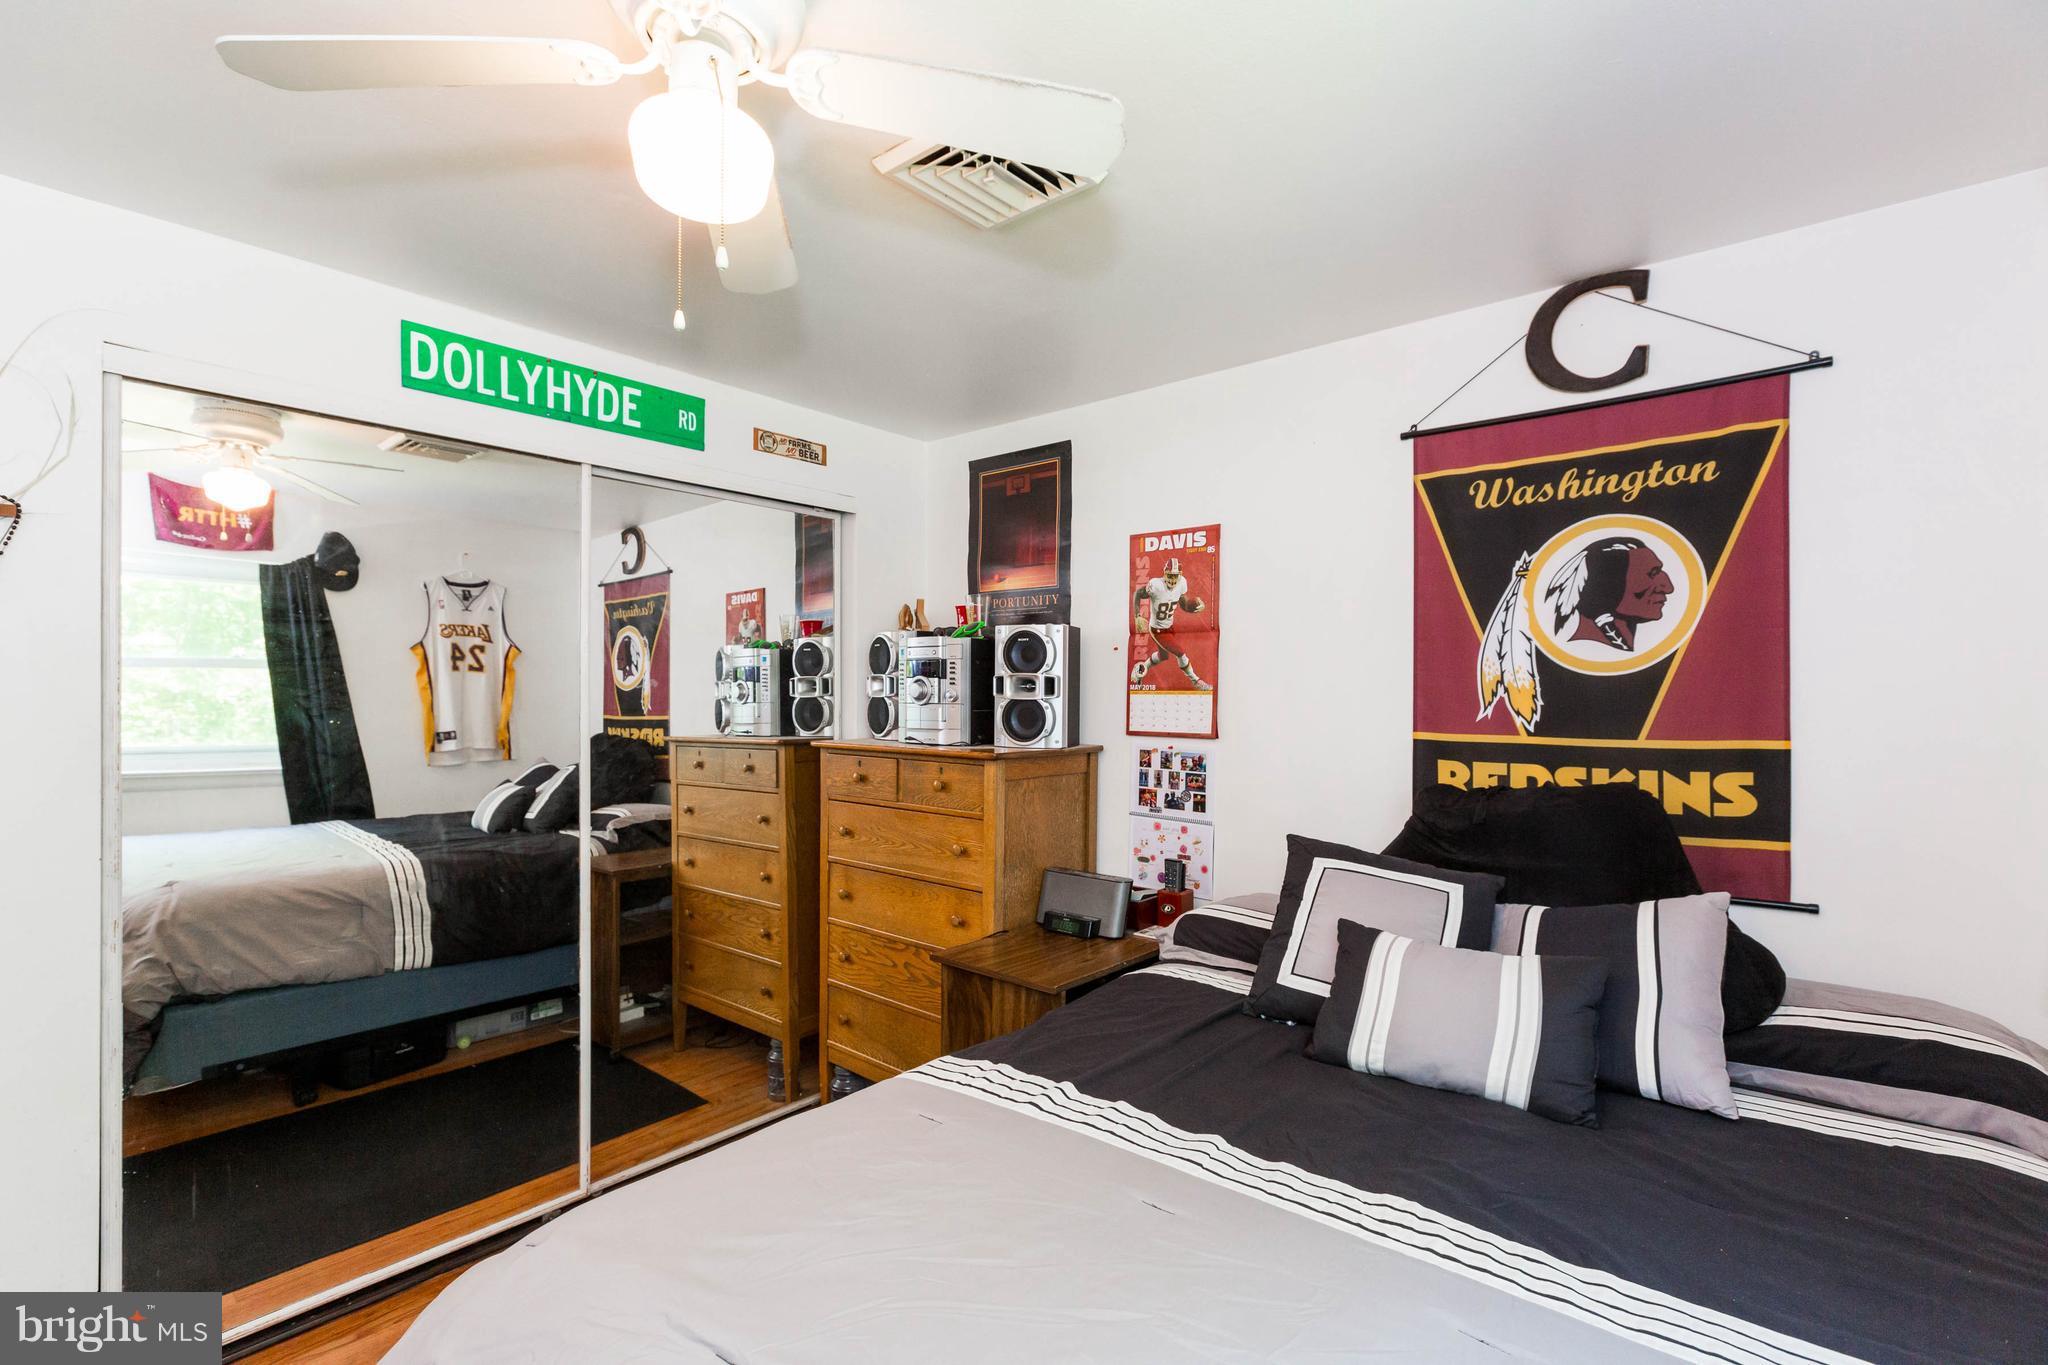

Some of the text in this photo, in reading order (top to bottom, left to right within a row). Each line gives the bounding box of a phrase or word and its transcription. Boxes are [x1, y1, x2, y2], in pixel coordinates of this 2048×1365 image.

[1525, 269, 1650, 394] C
[409, 331, 697, 431] DOLLYHYDE RD
[788, 439, 812, 450] FARMS
[798, 449, 820, 461] BEER
[1469, 459, 1720, 509] Washington
[1145, 531, 1207, 552] DAVIS
[992, 594, 1060, 609] PORTUNITY
[1134, 555, 1150, 661] RESINS
